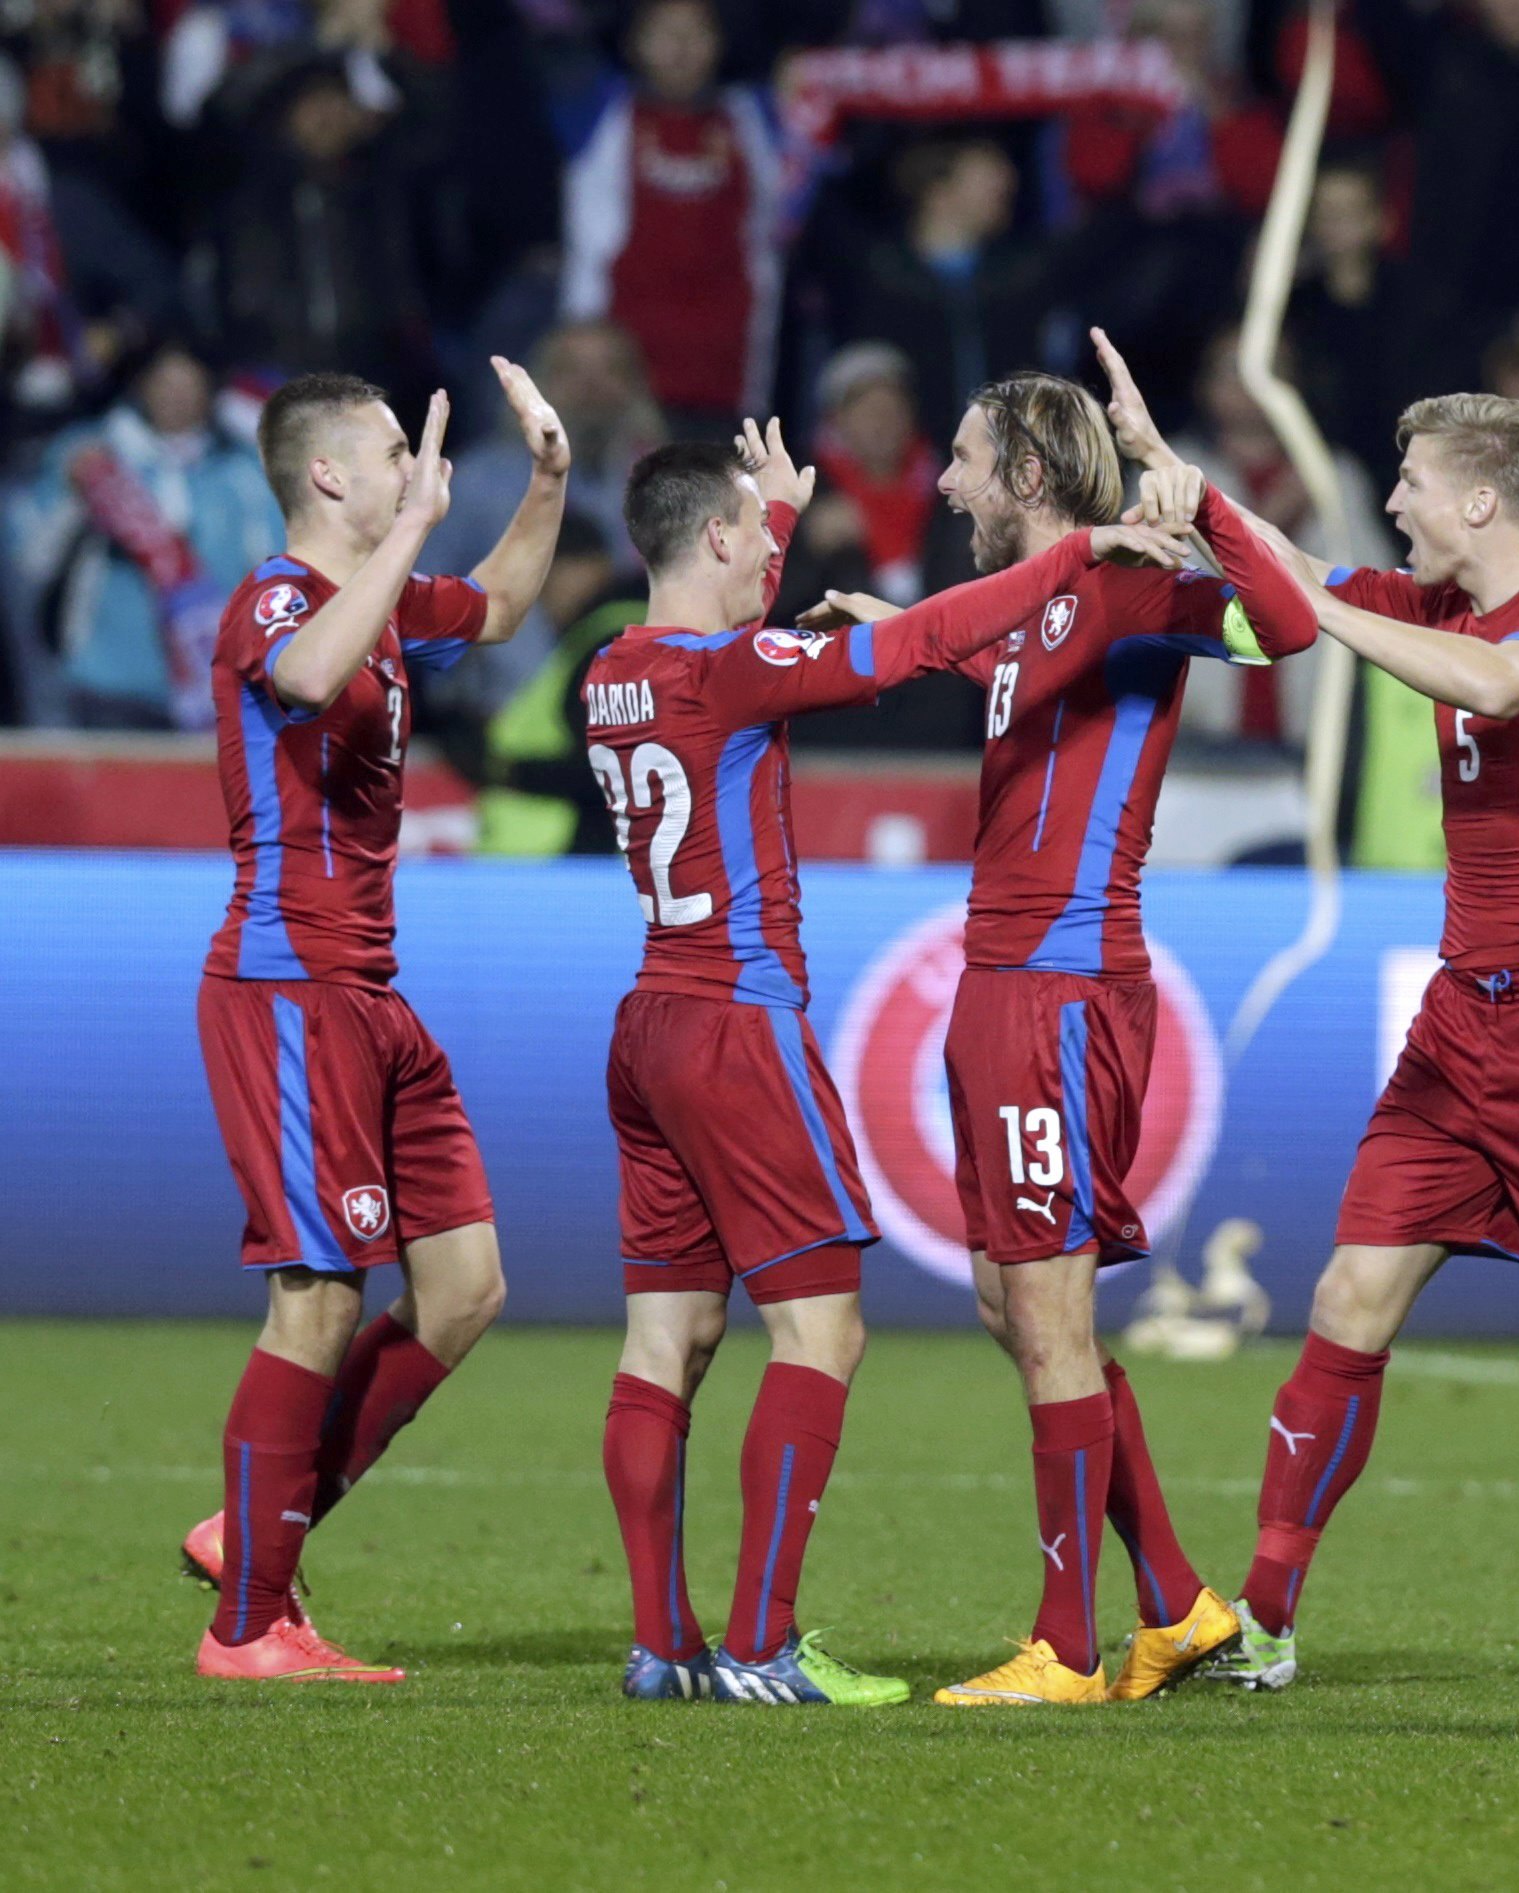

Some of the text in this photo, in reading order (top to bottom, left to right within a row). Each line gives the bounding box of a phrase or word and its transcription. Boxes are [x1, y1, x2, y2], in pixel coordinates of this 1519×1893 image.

[586, 679, 655, 726] DARIDA
[988, 661, 1020, 739] 13
[1455, 708, 1480, 782] 5
[587, 742, 713, 926] 22
[999, 1106, 1064, 1186] 13
